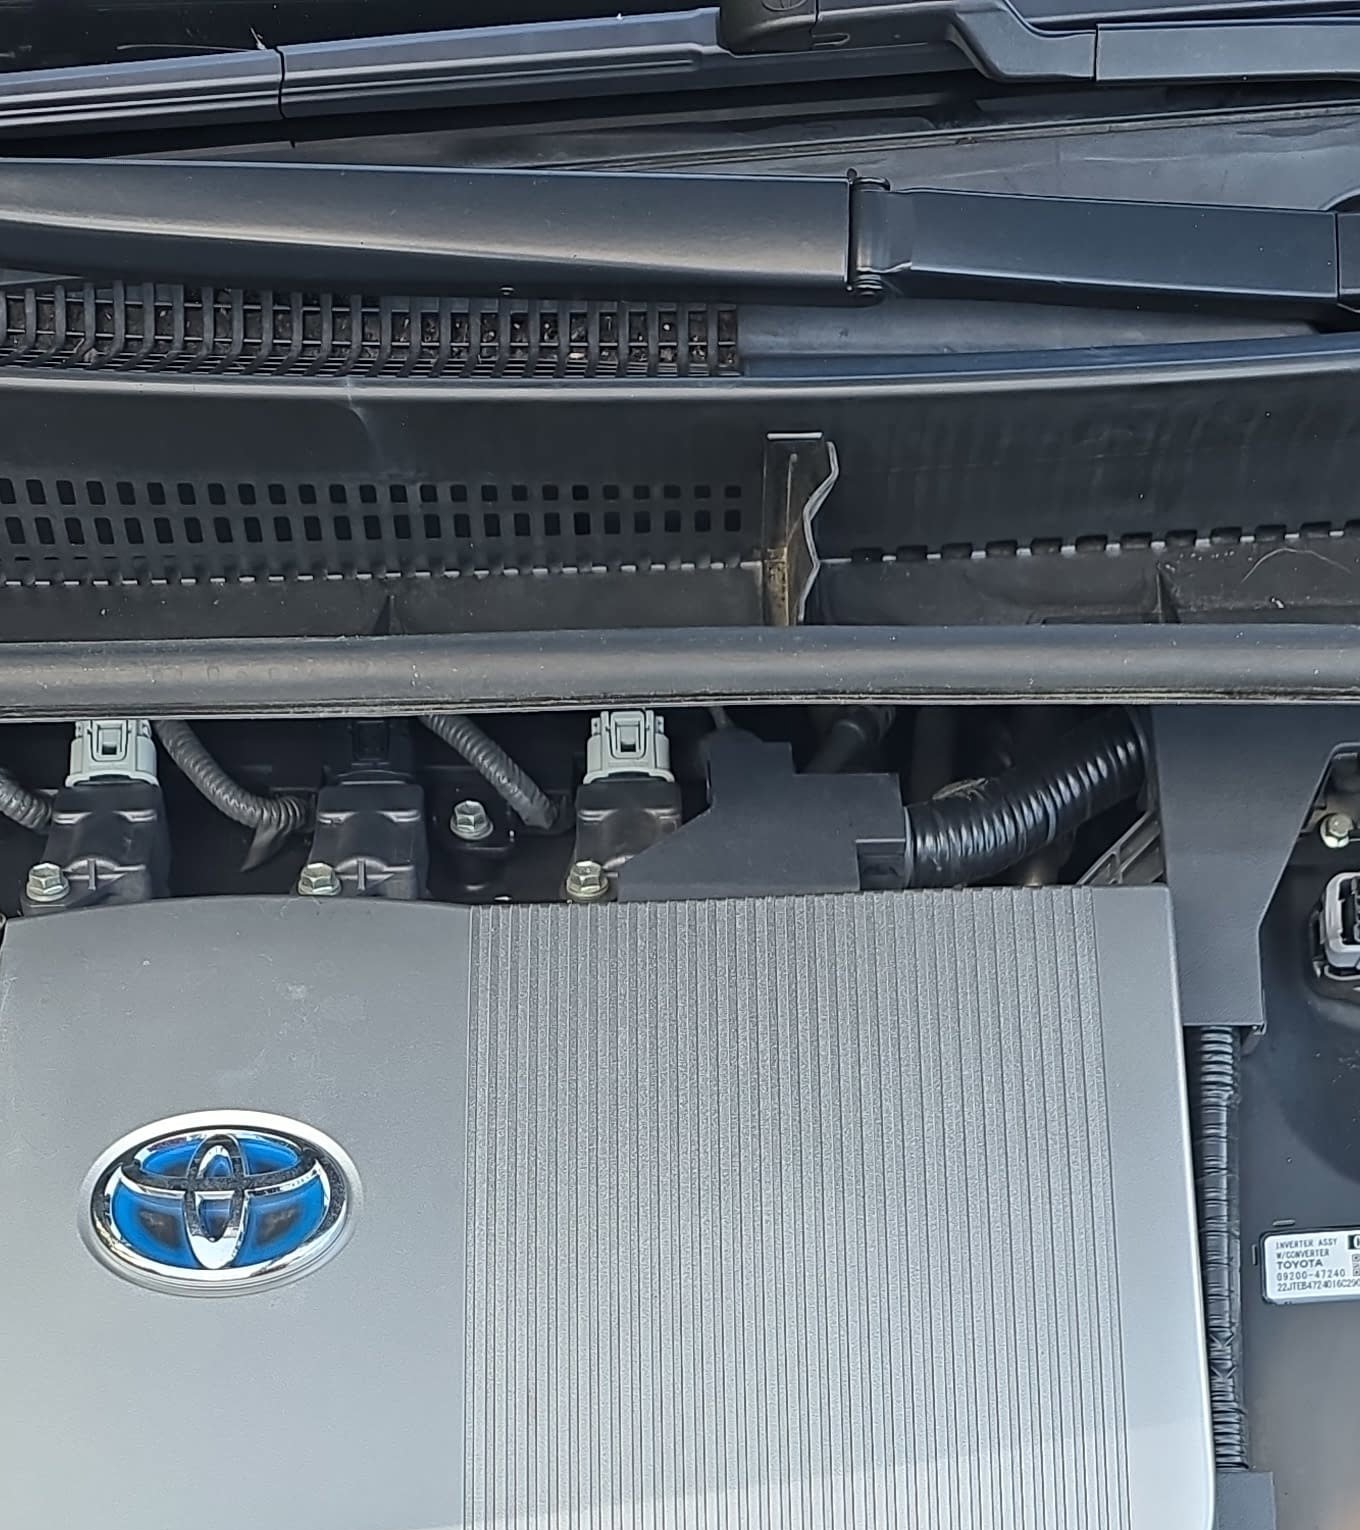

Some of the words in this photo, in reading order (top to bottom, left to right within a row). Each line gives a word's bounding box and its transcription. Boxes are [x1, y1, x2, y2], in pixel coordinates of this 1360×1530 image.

[1276, 1239, 1313, 1249] INVERTER
[1318, 1237, 1337, 1246] ASSY
[1276, 1258, 1322, 1269] TOYOTA
